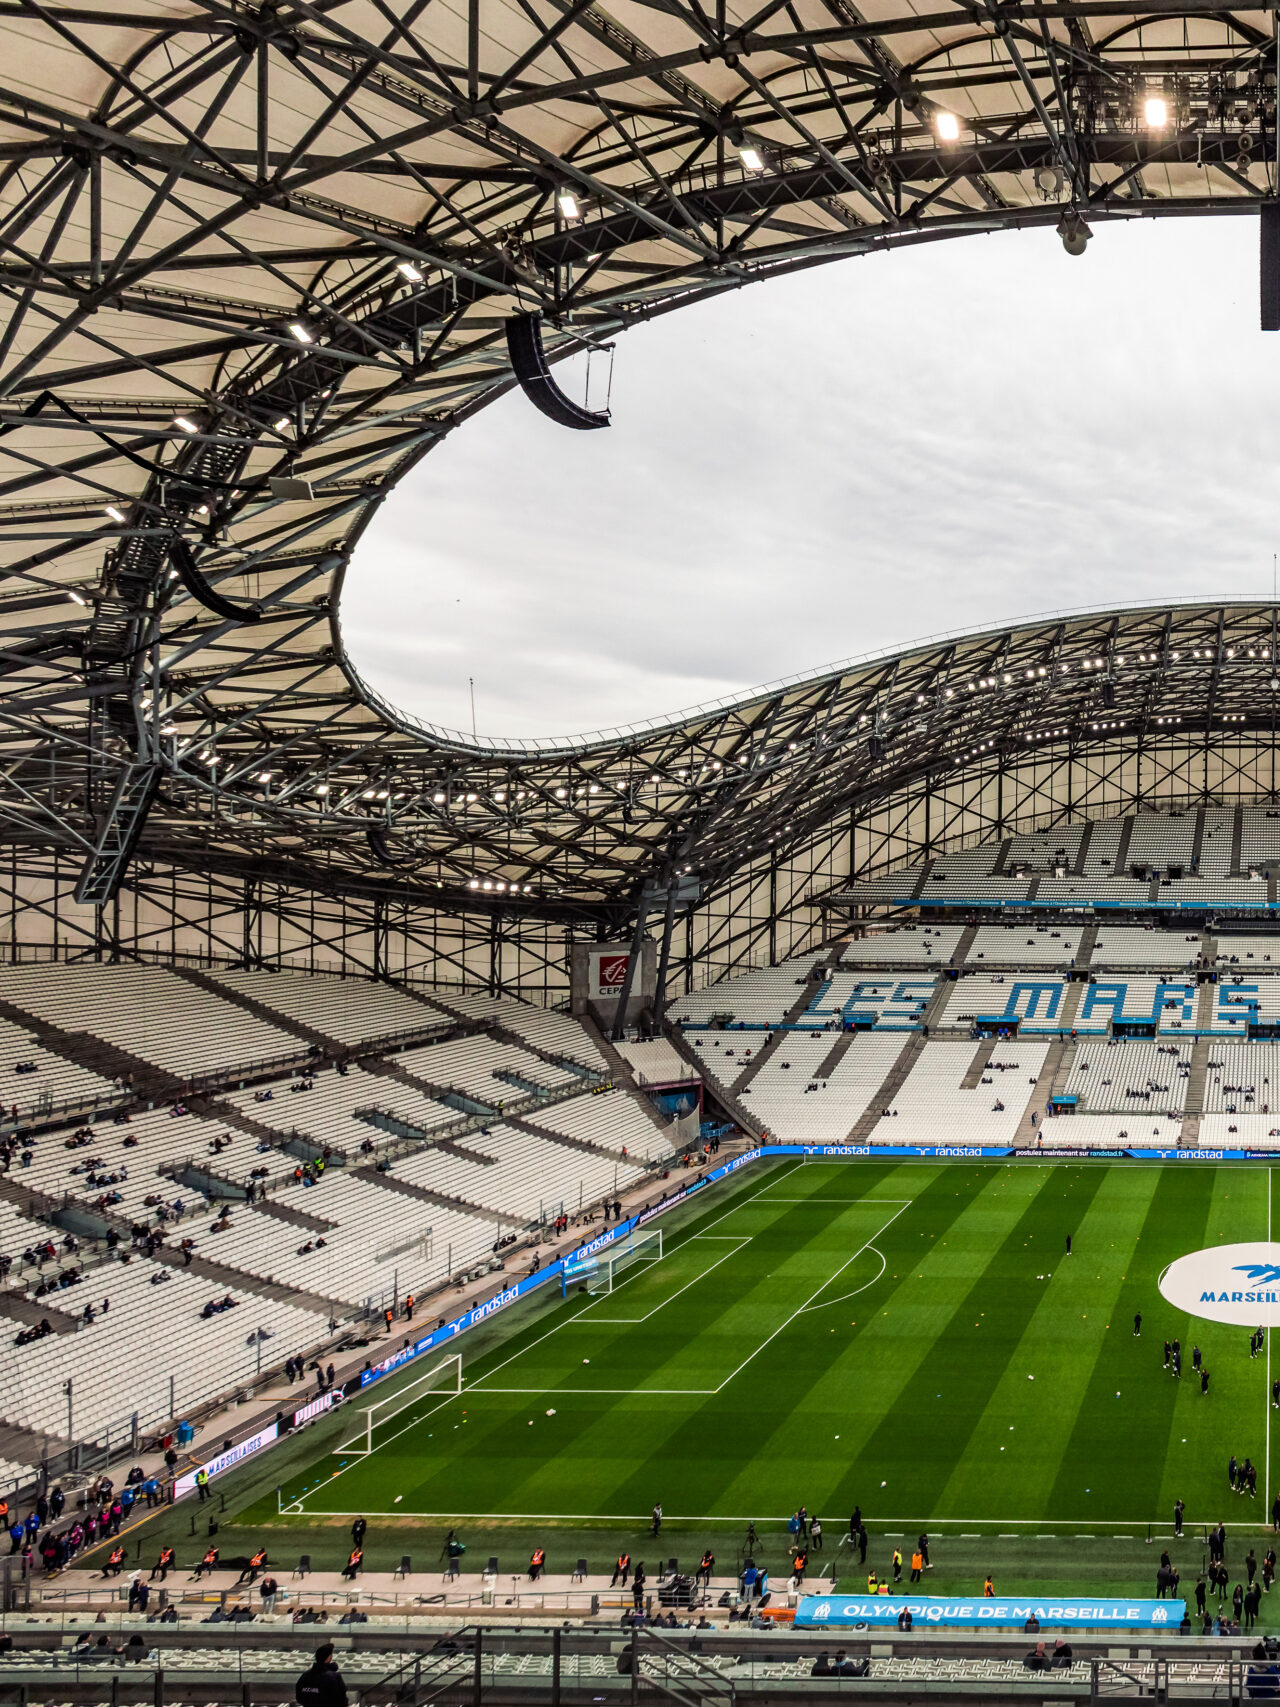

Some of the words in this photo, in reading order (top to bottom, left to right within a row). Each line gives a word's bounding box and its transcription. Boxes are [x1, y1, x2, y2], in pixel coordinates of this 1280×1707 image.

[599, 986, 632, 995] CEP
[823, 1145, 870, 1155] randstad
[935, 1146, 982, 1157] randstad
[1015, 1149, 1042, 1157] postulez
[1090, 1149, 1123, 1157] randstad.fr
[1176, 1149, 1223, 1159] randstad
[732, 1148, 761, 1169] randstad
[577, 1229, 615, 1261] randstad
[470, 1284, 519, 1324] randstad
[208, 1436, 262, 1475] MARSEILLAISES
[843, 1604, 974, 1622] OLYMPIQUE
[977, 1606, 1008, 1618] DE
[1012, 1607, 1140, 1620] MARSEILLE
